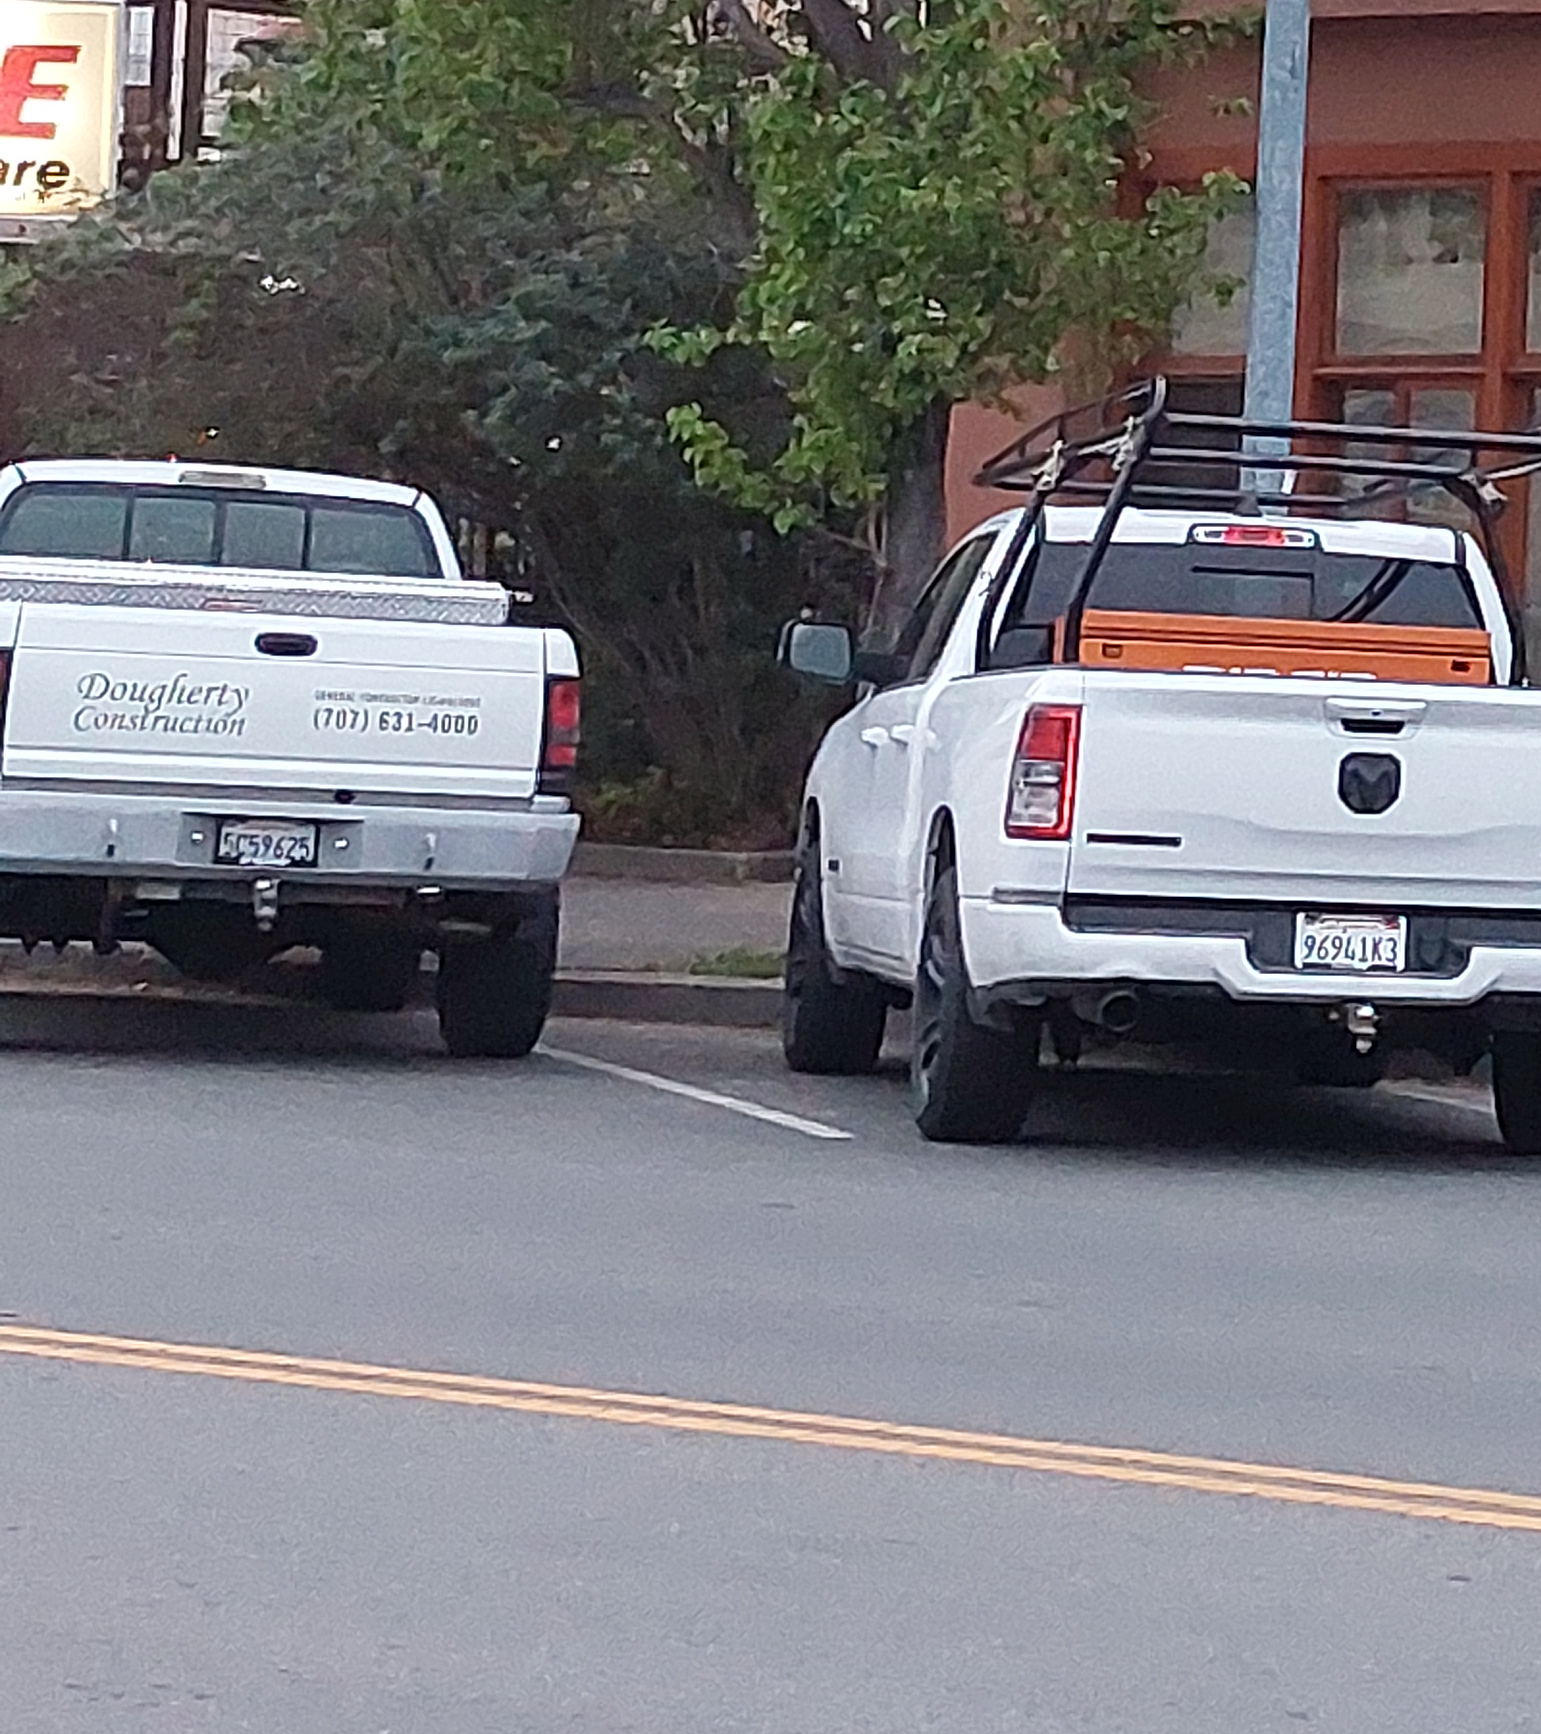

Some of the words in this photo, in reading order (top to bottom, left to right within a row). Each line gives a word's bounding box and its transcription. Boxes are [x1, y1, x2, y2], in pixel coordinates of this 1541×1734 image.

[77, 673, 250, 716] Dougherty
[74, 705, 246, 737] Construction
[313, 708, 369, 732] (707)
[379, 711, 479, 735] 631-4000
[1303, 934, 1397, 963] 96941K3
